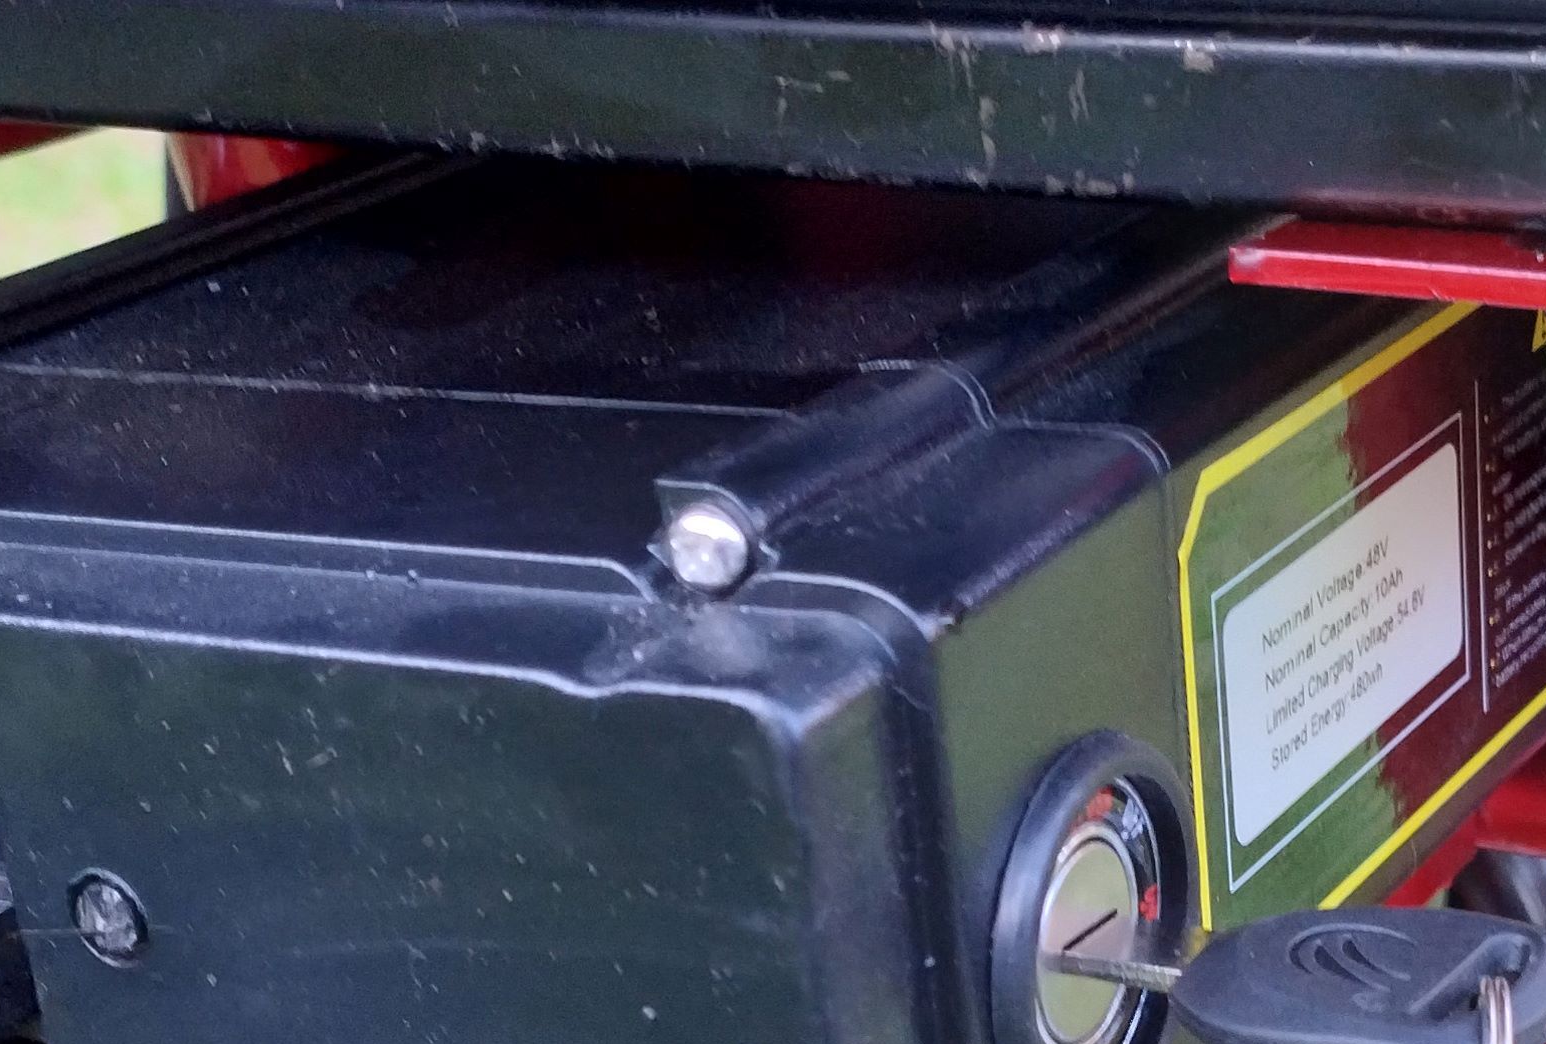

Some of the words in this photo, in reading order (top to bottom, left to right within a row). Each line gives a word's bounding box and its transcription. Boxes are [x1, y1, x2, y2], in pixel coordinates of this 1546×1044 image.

[1262, 597, 1314, 654] Nominal
[1264, 635, 1316, 693] Nominal
[1266, 684, 1306, 736] Limited
[1307, 649, 1355, 698] Charging
[1271, 723, 1308, 771] Stored
